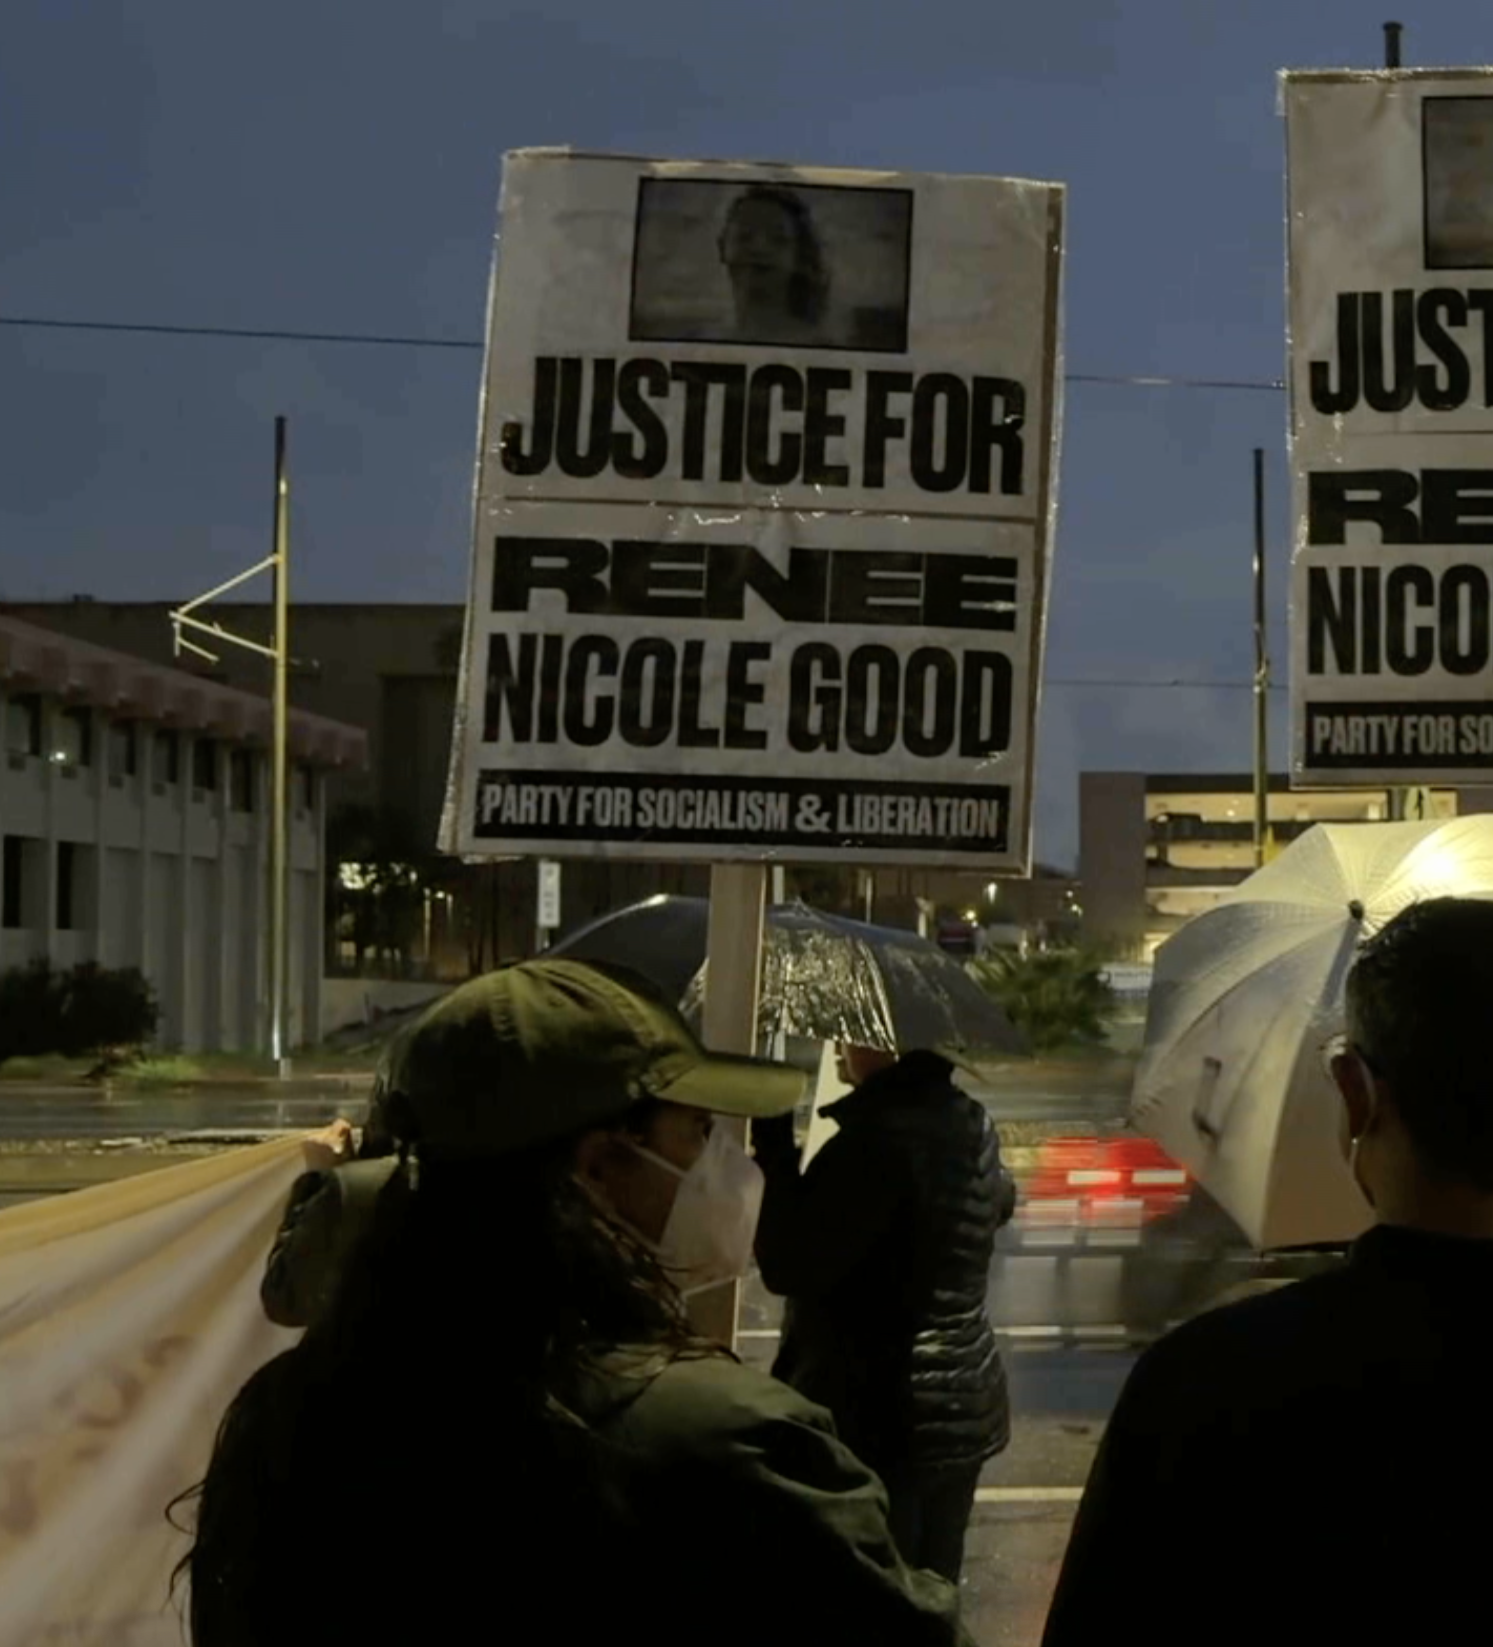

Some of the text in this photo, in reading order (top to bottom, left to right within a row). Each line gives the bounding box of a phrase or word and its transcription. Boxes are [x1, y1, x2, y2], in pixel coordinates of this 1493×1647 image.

[502, 355, 1027, 496] JUSTICE FOR
[490, 536, 1019, 632] RENEE
[480, 632, 1013, 759] NICOLE GOOD
[1312, 715, 1400, 755] PARTY
[1402, 714, 1458, 755] FOR
[480, 783, 999, 840] PARTY FOR SOCIALISM & LIBERATION
